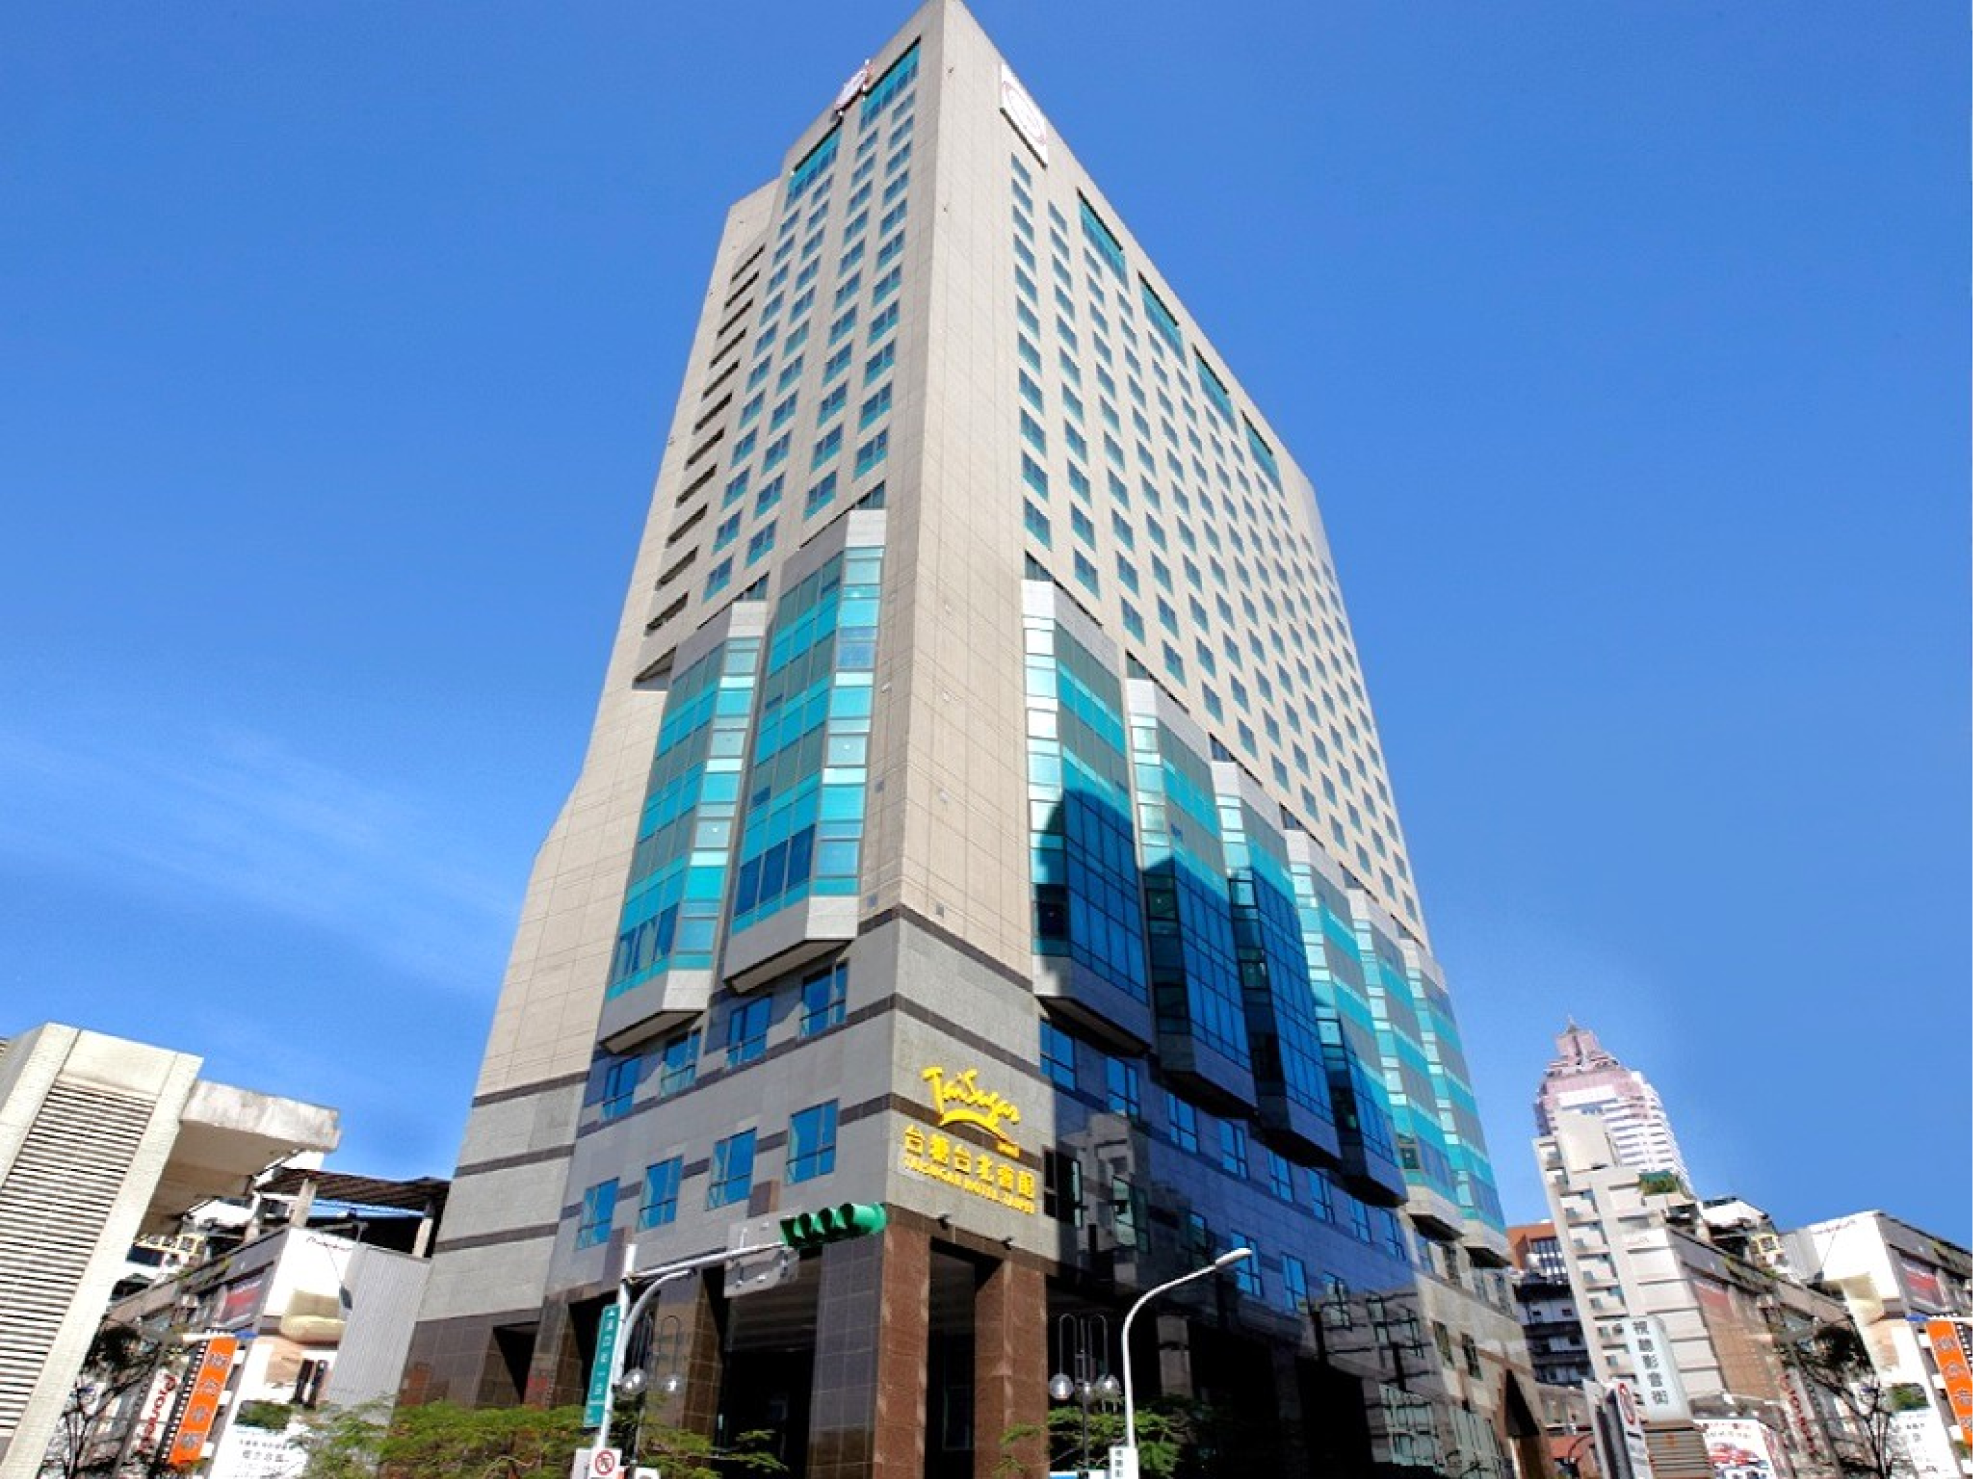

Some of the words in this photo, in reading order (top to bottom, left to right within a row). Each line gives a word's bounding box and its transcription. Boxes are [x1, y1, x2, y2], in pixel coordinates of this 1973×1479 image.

[904, 1125, 1036, 1199] 台糖台北會館
[964, 1176, 999, 1202] HOTEL
